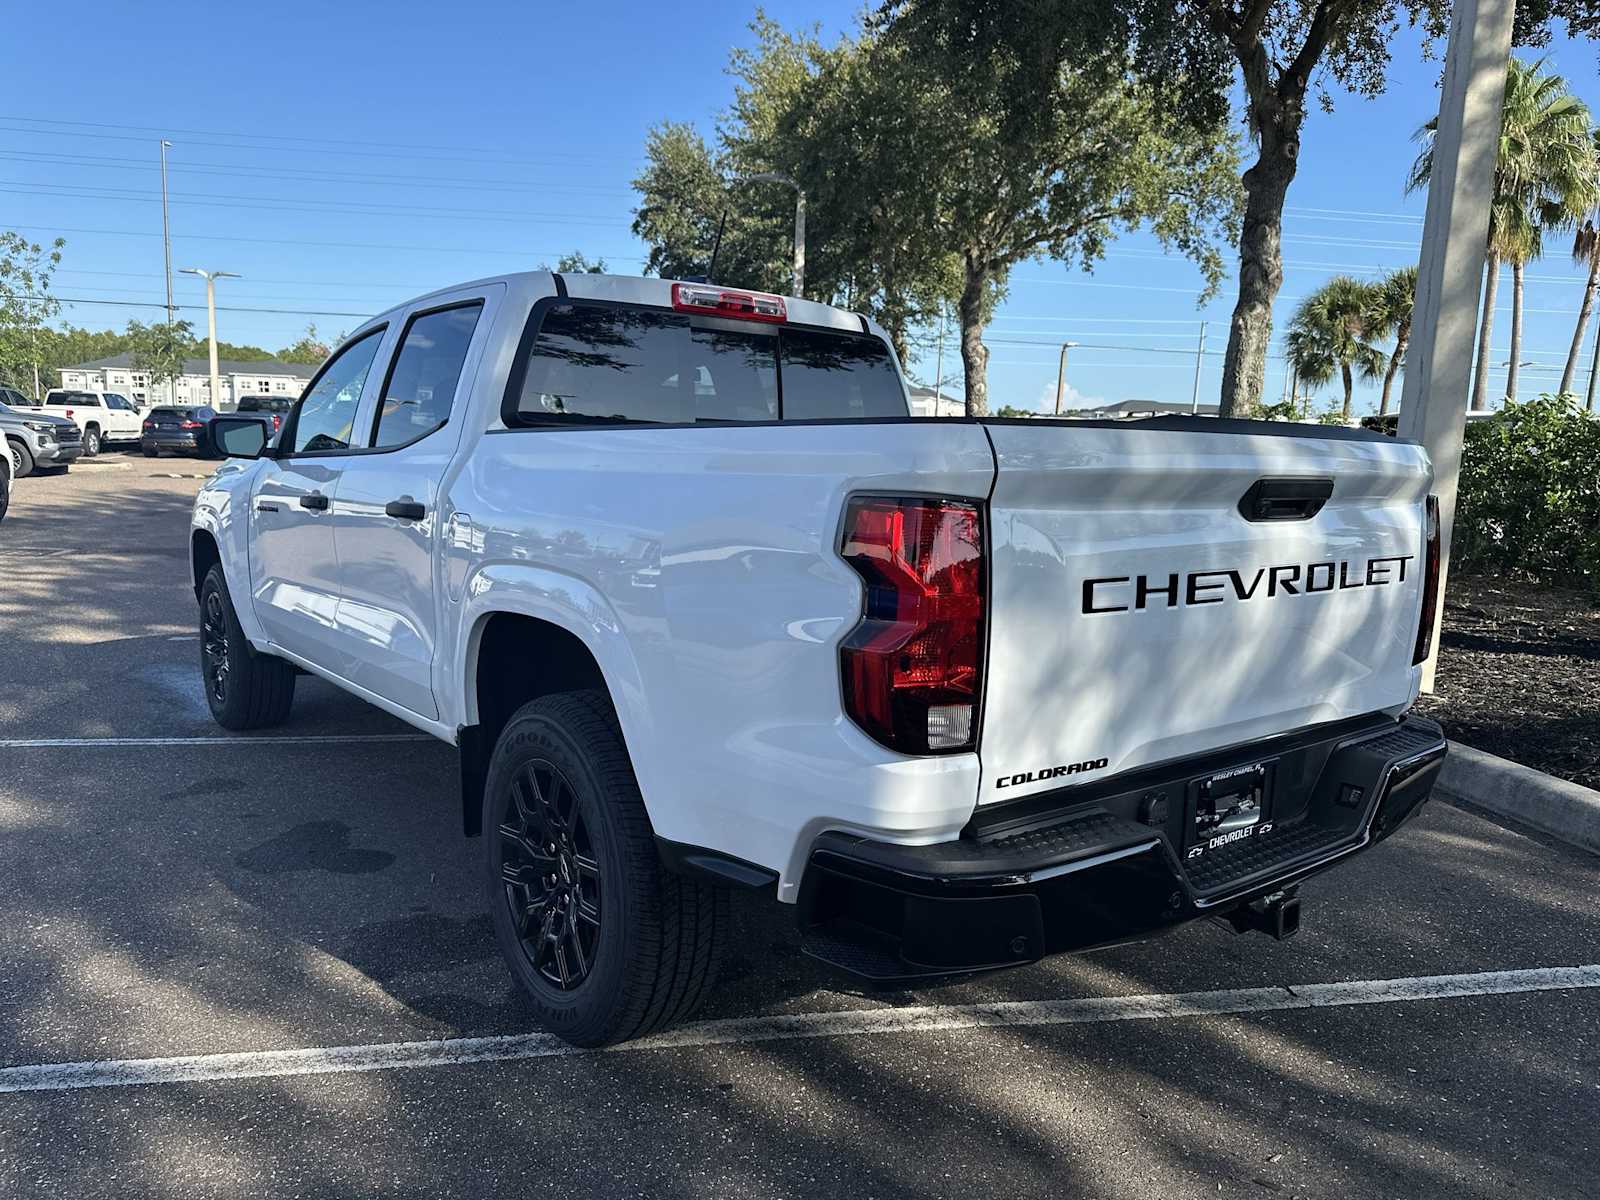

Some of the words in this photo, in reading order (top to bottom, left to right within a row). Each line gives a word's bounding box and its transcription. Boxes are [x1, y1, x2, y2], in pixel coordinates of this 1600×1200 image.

[1081, 556, 1414, 614] CHEVROLET
[996, 758, 1108, 788] COLORADO
[1209, 826, 1254, 849] CHEVROLET
